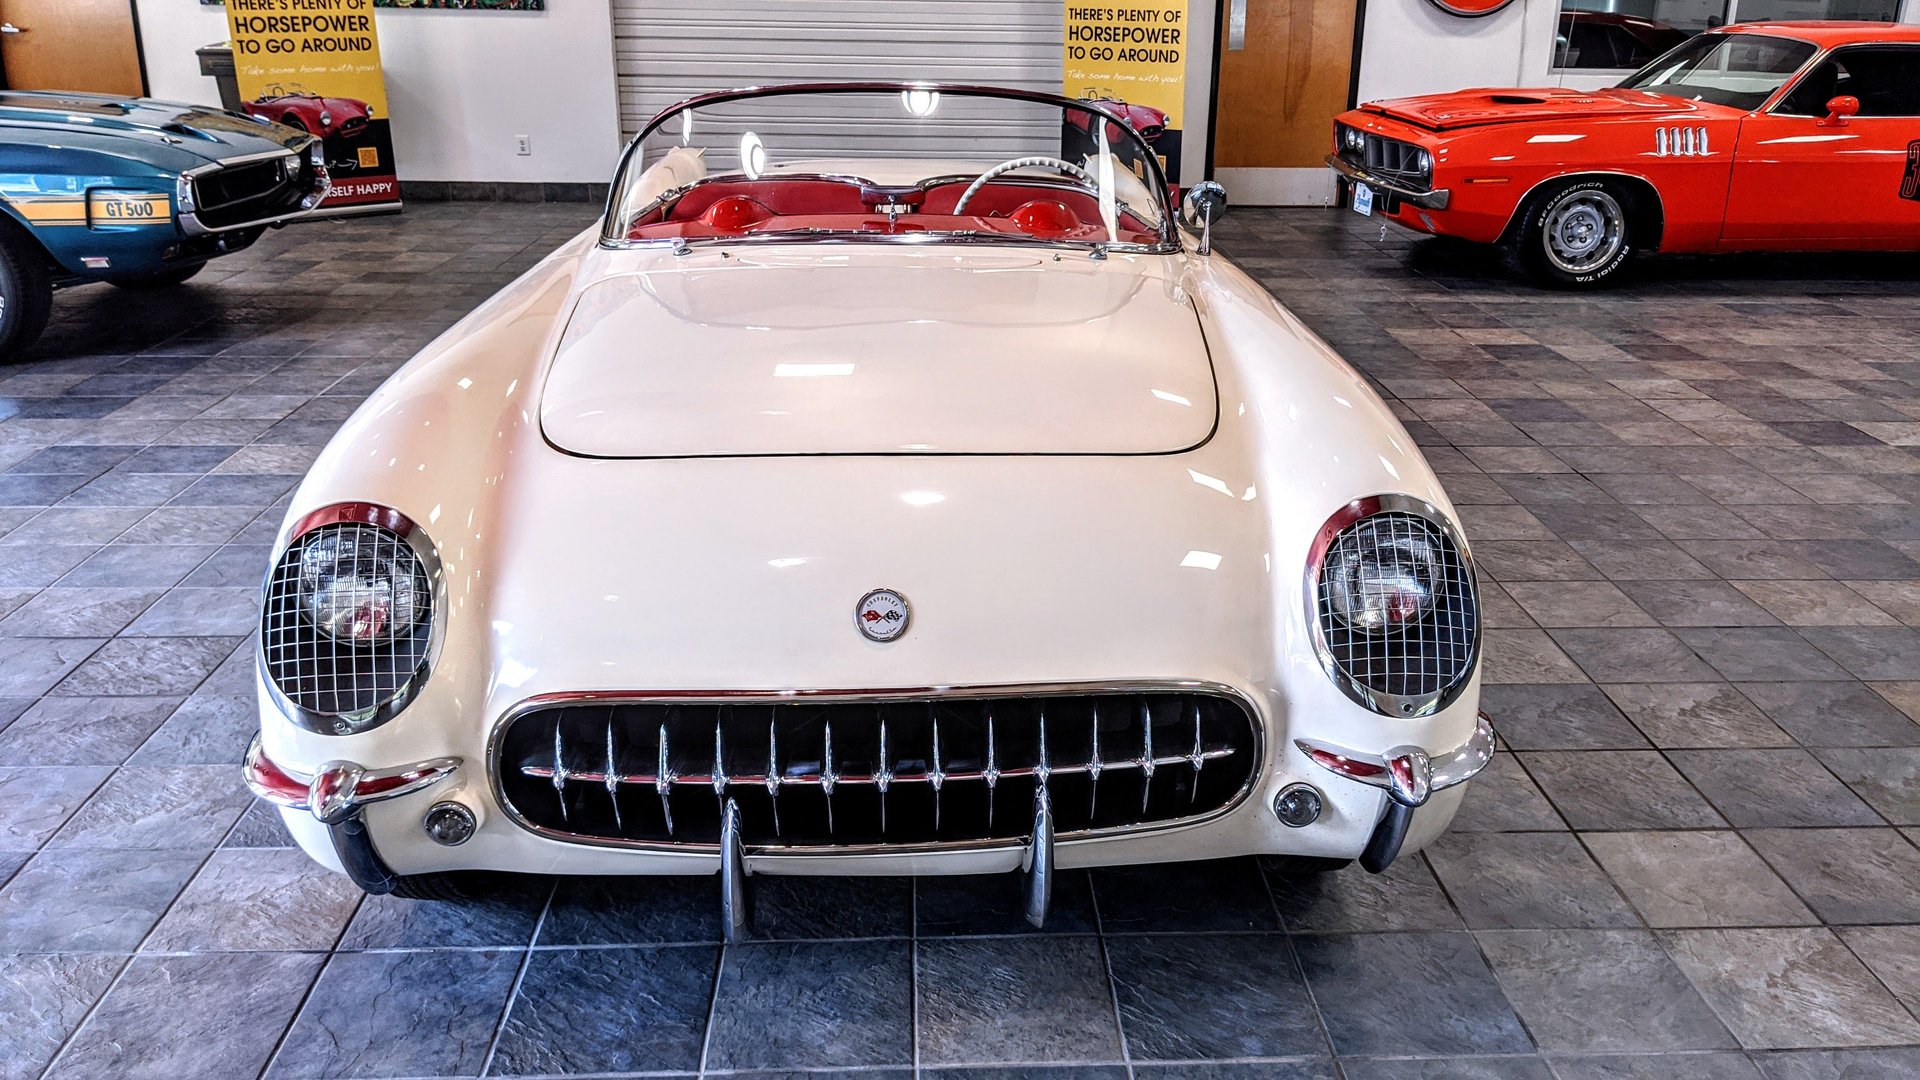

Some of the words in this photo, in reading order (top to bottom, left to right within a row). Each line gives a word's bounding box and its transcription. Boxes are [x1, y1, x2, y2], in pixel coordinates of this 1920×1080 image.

[293, 0, 341, 10] PLENTY
[347, 0, 367, 9] OF
[1068, 8, 1114, 21] THERE'S
[1117, 9, 1160, 22] PLENTY
[1164, 10, 1181, 23] OF
[234, 15, 370, 33] HORSEPOWER
[1069, 25, 1181, 44] HORSEPOWER
[237, 39, 260, 54] TO
[266, 38, 295, 53] GO
[301, 37, 372, 53] AROUND
[1068, 46, 1086, 60] TO
[1090, 47, 1113, 61] GO
[1117, 48, 1179, 63] AROUND
[240, 65, 264, 75] Take
[300, 64, 327, 74] home
[331, 63, 354, 73] with
[356, 63, 379, 74] you!
[1067, 69, 1085, 79] Take
[1088, 72, 1111, 80] some
[1114, 73, 1136, 81] home
[1138, 74, 1159, 83] with
[1160, 74, 1183, 85] you!
[325, 185, 354, 198] RSELF
[356, 182, 392, 195] HAPPY
